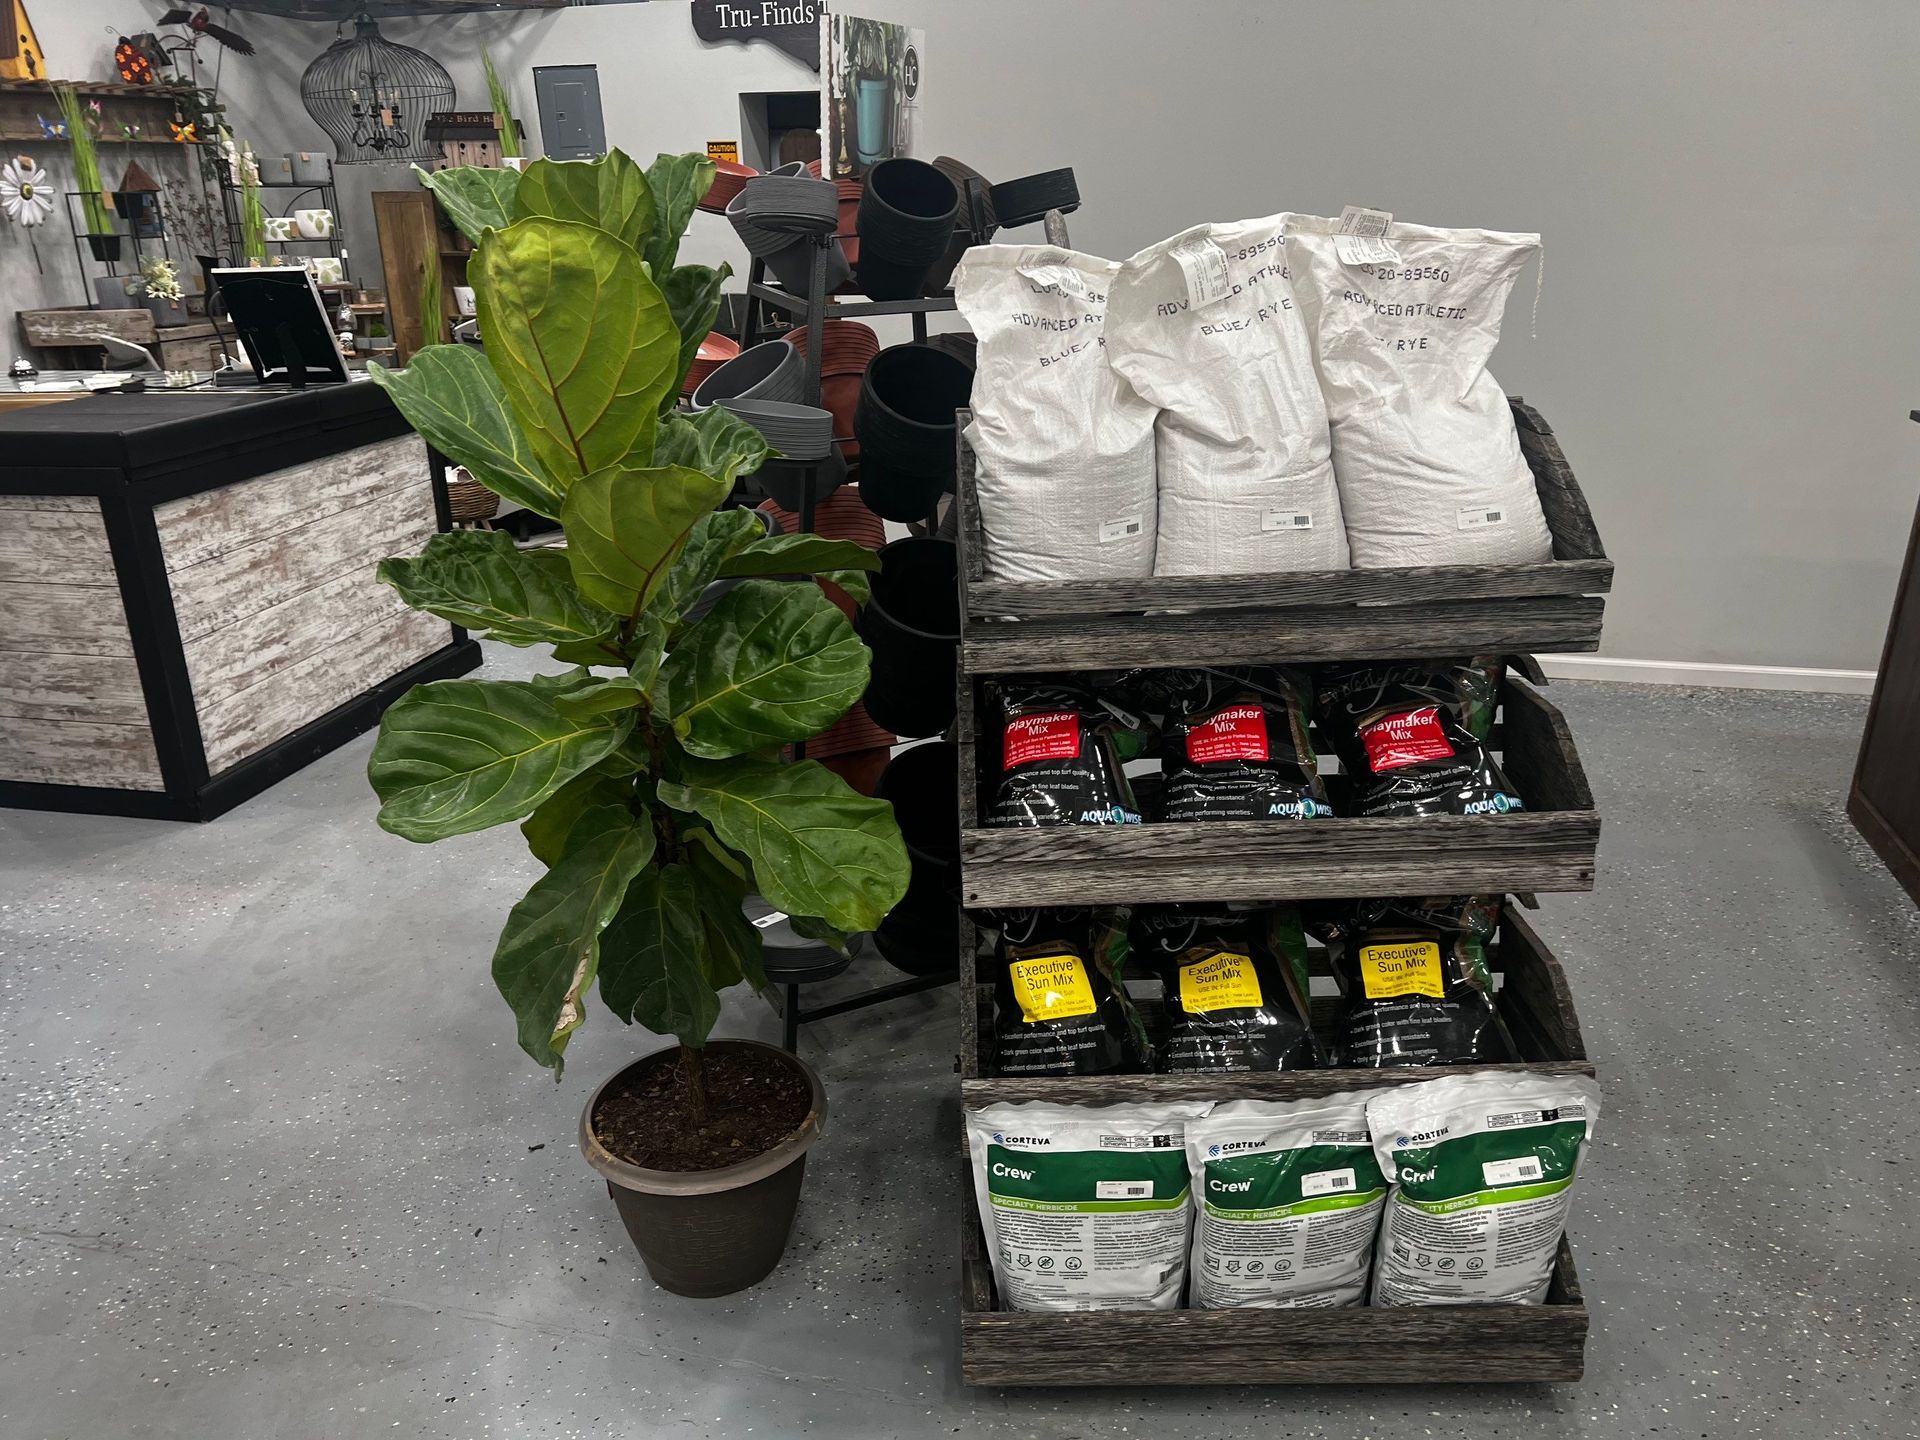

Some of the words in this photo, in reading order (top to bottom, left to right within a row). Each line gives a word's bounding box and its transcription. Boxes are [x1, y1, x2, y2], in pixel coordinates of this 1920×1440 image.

[715, 0, 815, 29] Tru-Finds
[905, 65, 918, 87] HC
[457, 115, 480, 123] Bird
[709, 144, 736, 153] CAUTION
[1257, 298, 1293, 322] RYE
[1012, 313, 1078, 332] ADVANCED
[1397, 338, 1428, 351] RYE
[1006, 713, 1075, 734] Playmaker
[1028, 724, 1049, 736] Mix
[1214, 720, 1237, 734] Mix
[1390, 729, 1414, 741] Mix
[1072, 769, 1090, 778] quality
[1194, 809, 1226, 817] performing
[1226, 808, 1251, 816] varieties
[1268, 803, 1299, 815] AQUA
[1464, 800, 1496, 815] AQUA
[1080, 810, 1112, 823] AQUA
[1377, 960, 1404, 974] Sun
[1405, 957, 1428, 971] Mix
[1026, 976, 1050, 991] Sun
[1053, 974, 1075, 988] Mix
[1196, 974, 1219, 985] Sun
[1222, 967, 1243, 980] Mix
[1433, 1016, 1453, 1024] blades
[1004, 1032, 1023, 1040] Excellent
[1023, 1031, 1056, 1040] performance
[1067, 1028, 1077, 1036] top
[1077, 1026, 1088, 1034] turf
[1087, 1024, 1106, 1033] quality
[1003, 1048, 1014, 1056] Dark
[1014, 1048, 1029, 1056] green
[1029, 1047, 1043, 1055] color
[1067, 1043, 1078, 1051] leaf
[1078, 1041, 1097, 1049] blades
[1003, 1063, 1026, 1072] Excellent
[1026, 1063, 1046, 1071] disease
[1005, 1136, 1051, 1146] CORTEVA
[1411, 1127, 1449, 1142] CORTEVA
[1222, 1140, 1267, 1151] CORTEVA
[992, 1196, 1034, 1210] SPECIALTY
[1035, 1203, 1079, 1212] HERBICIDE
[1444, 1196, 1480, 1211] HERBICIDE
[1208, 1207, 1252, 1220] SPECIALTY
[1252, 1207, 1293, 1220] HERBICIDE
